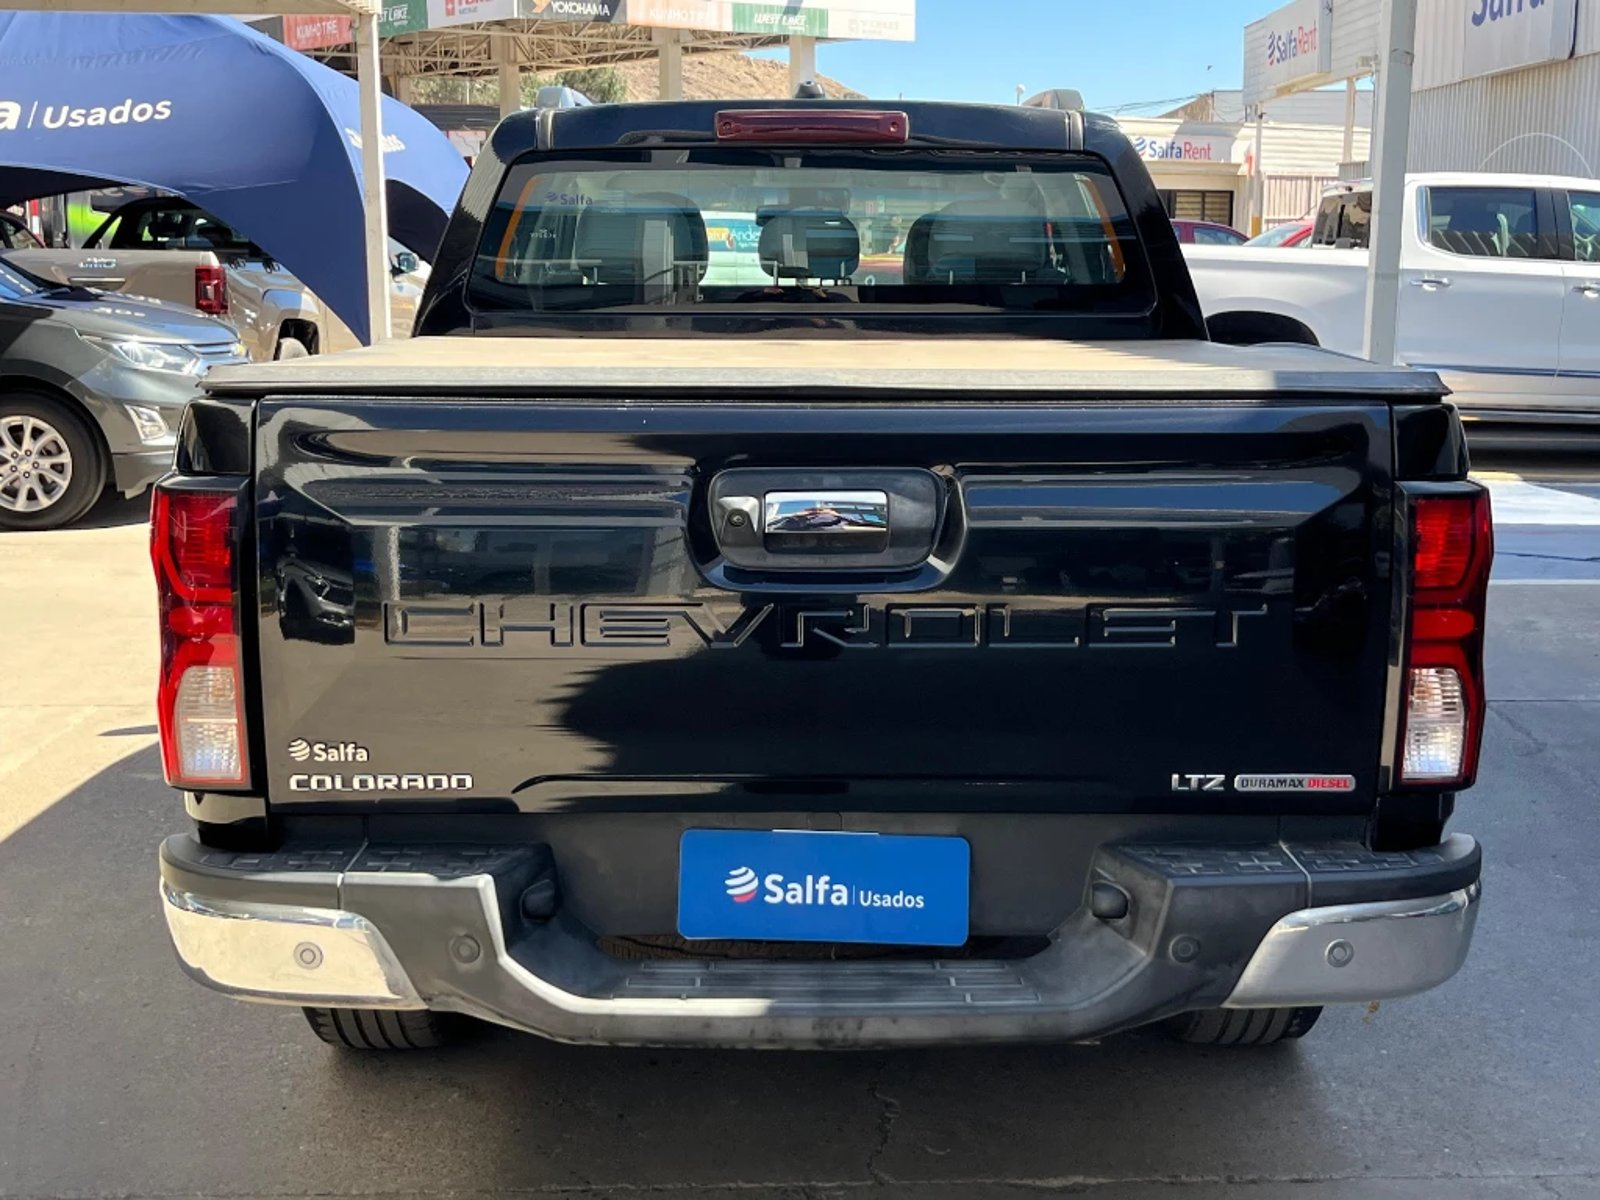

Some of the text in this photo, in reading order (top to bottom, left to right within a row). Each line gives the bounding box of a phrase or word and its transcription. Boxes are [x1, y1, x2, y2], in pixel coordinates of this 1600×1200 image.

[551, 1, 611, 16] YOKOHAMA
[754, 13, 806, 26] WEST LAKE
[43, 98, 172, 129] Usados
[1149, 141, 1212, 160] SalfaRent
[560, 193, 593, 206] Salfa
[383, 601, 1268, 648] CHEVROLET
[313, 743, 369, 762] Salfa
[289, 774, 474, 791] COLORADO
[1171, 773, 1350, 791] LTZ DURAMAX DIESEL
[763, 873, 925, 908] Salfa Usados
